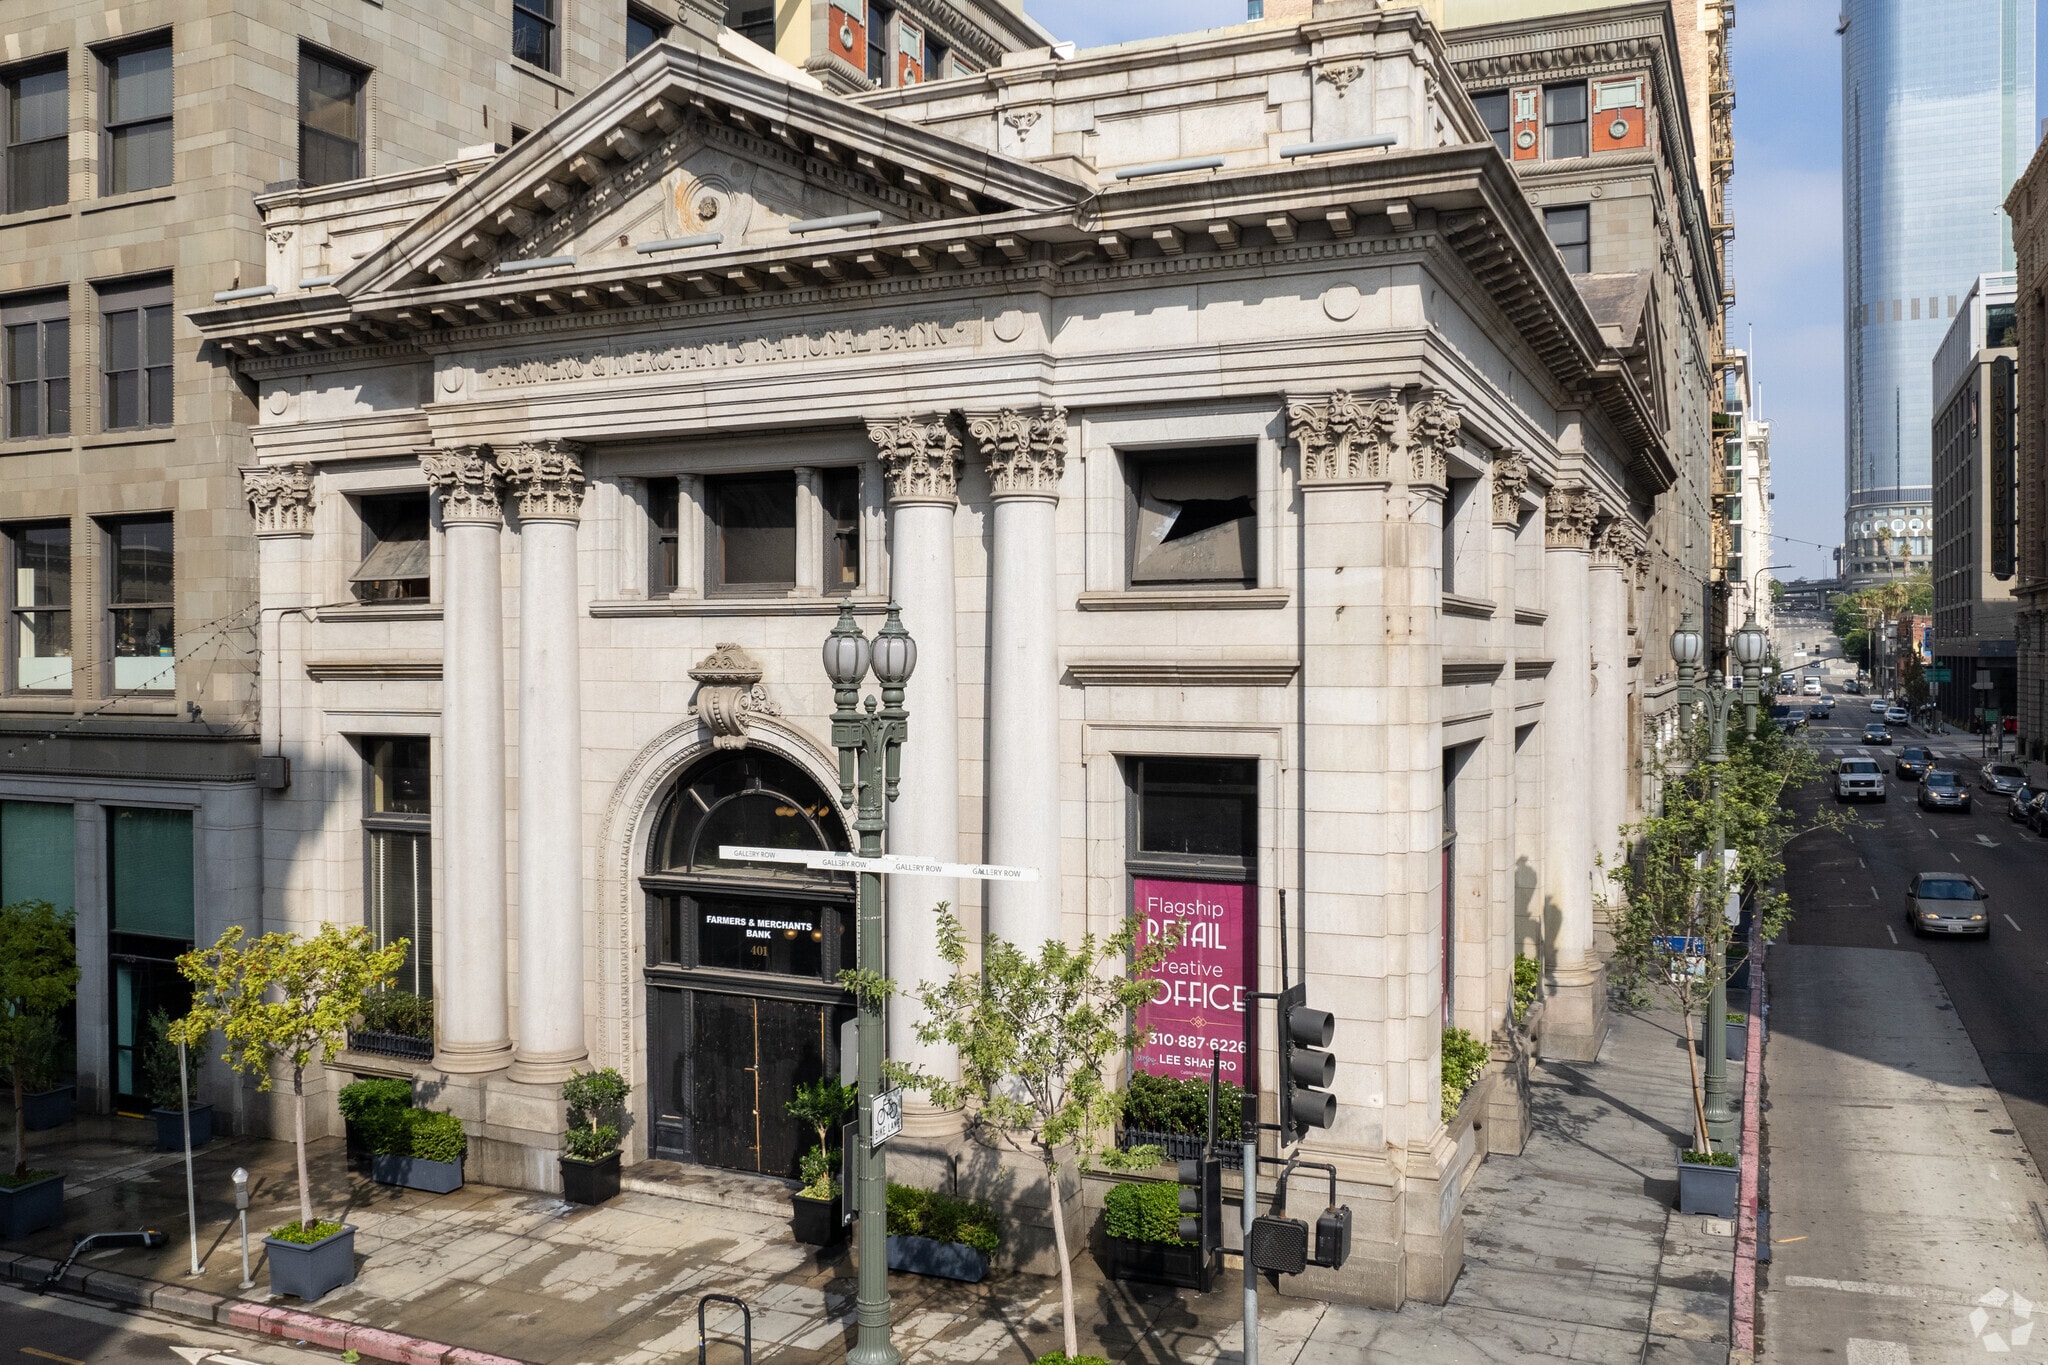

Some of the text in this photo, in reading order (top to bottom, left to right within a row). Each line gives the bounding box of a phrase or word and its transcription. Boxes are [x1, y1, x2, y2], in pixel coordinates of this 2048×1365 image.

[498, 316, 948, 386] FARMERS & MERCHANTS NATIONAL BANK
[1994, 385, 2006, 552] BANCO POPULAR
[734, 850, 775, 859] GALLERY ROW
[822, 859, 867, 868] GALLERY ROW
[895, 863, 942, 872] GALLERY ROW
[972, 868, 1003, 876] GALLERY
[1148, 897, 1224, 919] Flagship
[706, 915, 813, 931] FARMERS & MERCHANTS
[746, 929, 771, 939] BANK
[1147, 918, 1227, 950] RETAIL
[751, 945, 768, 956] 401
[1150, 959, 1223, 977] Creative
[1150, 978, 1247, 1012] OFFICE
[1159, 1053, 1181, 1066] LEE
[1184, 1056, 1236, 1071] SHAPRO
[875, 1118, 900, 1140] BIKE LANE
